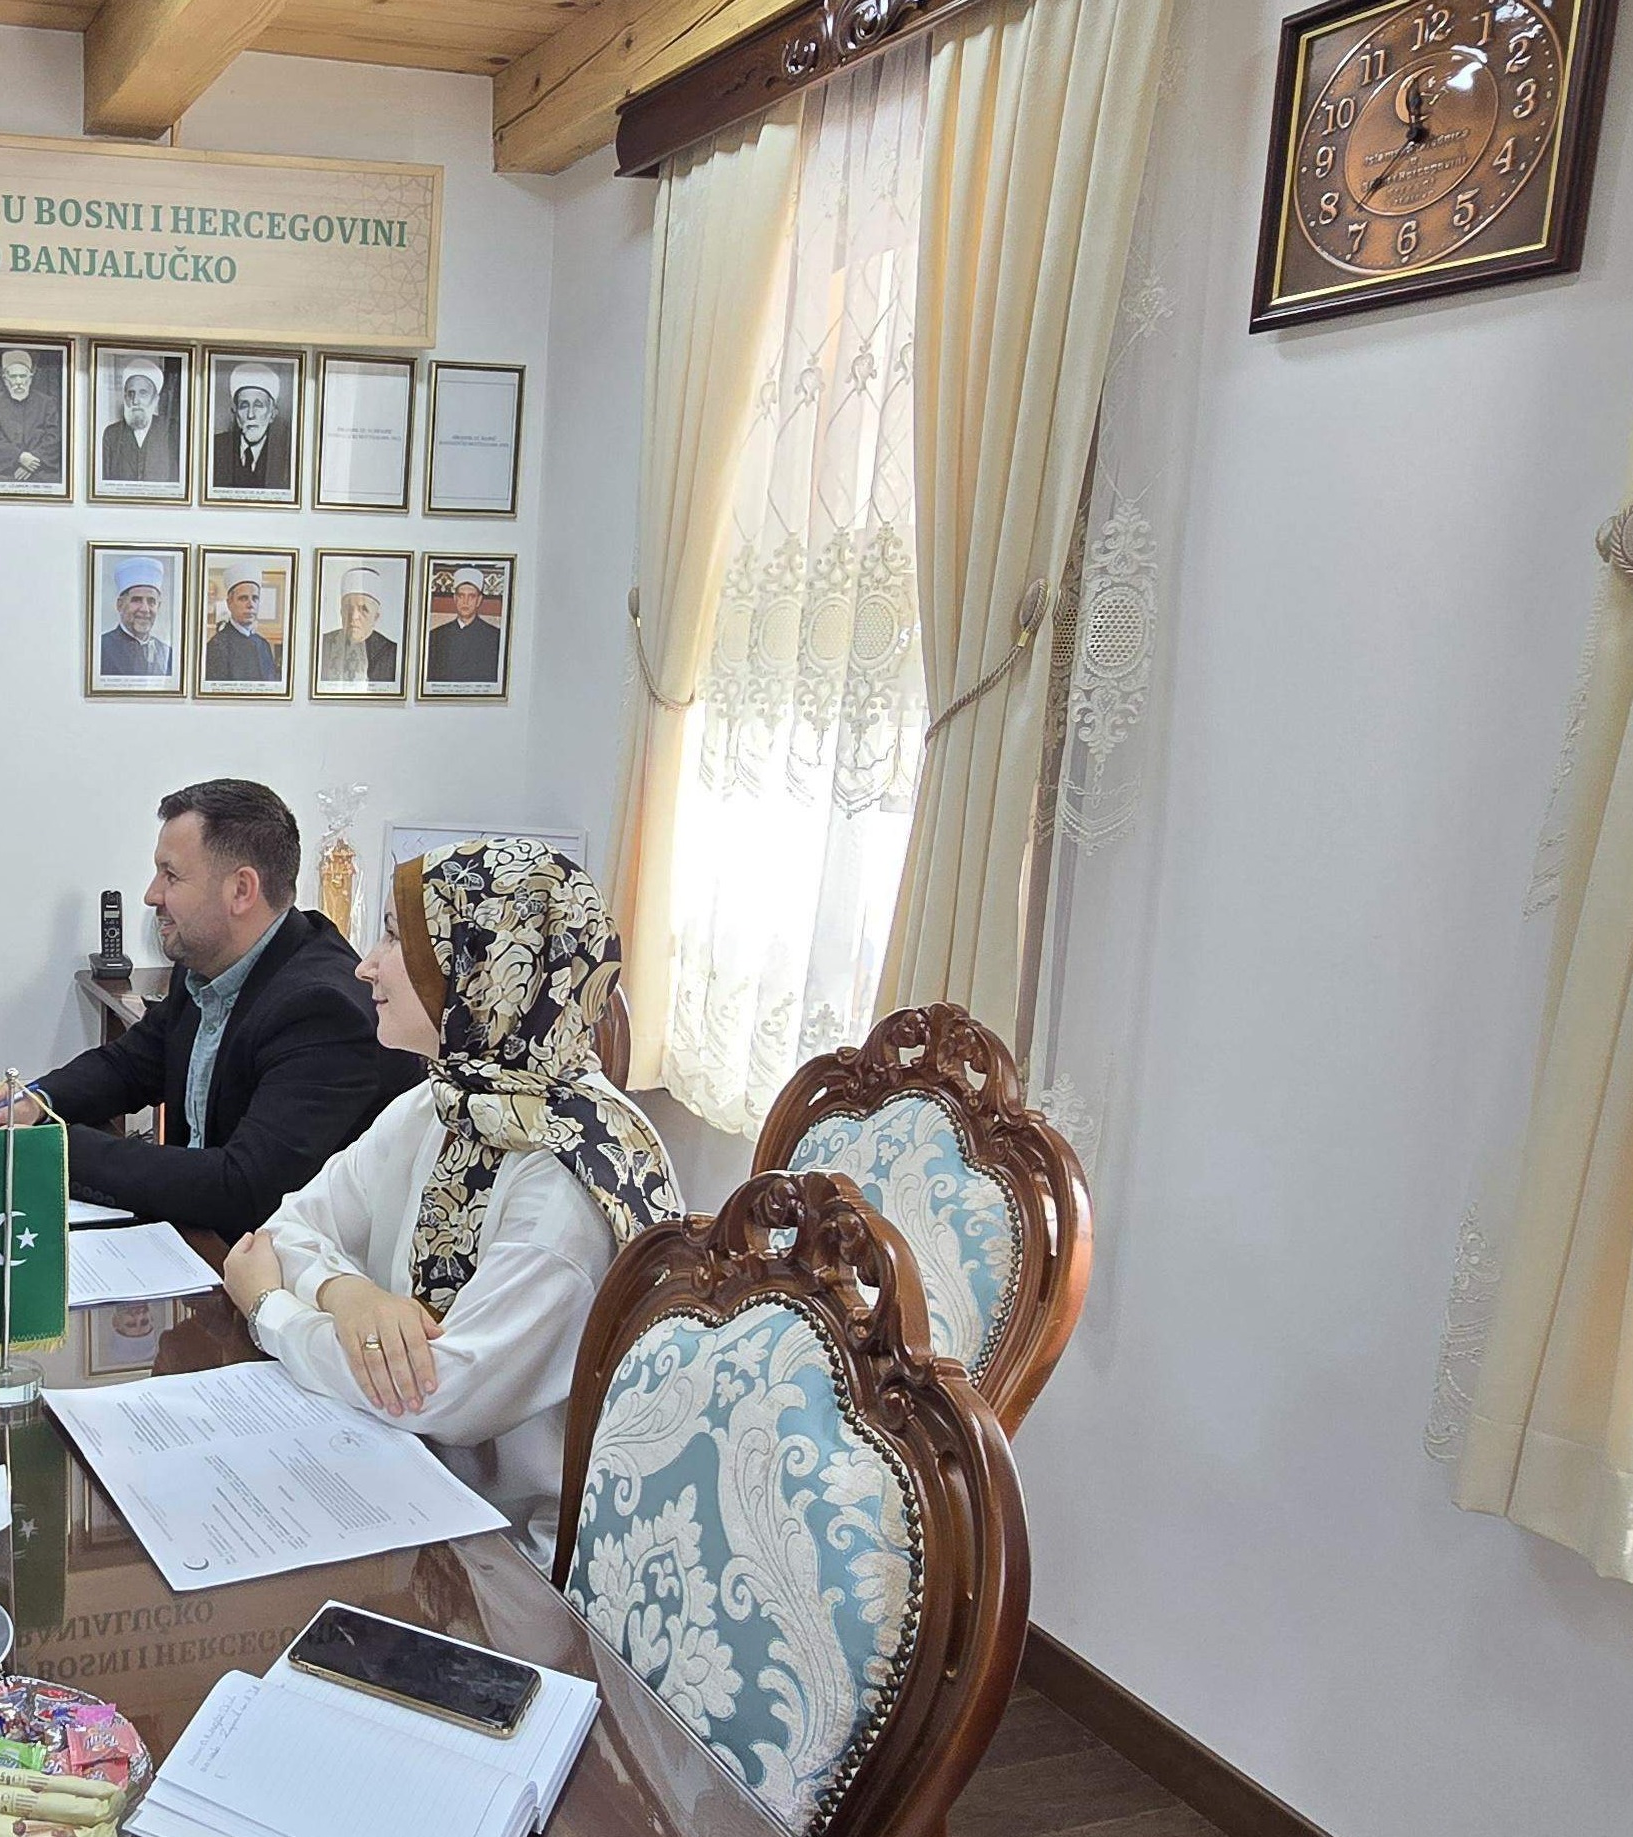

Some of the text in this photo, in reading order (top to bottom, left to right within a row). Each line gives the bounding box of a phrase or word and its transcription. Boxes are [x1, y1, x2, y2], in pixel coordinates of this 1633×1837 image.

[1412, 9, 1451, 51] 12
[1476, 11, 1493, 46] 1
[1361, 49, 1388, 86] 11
[1506, 37, 1530, 73] 2
[1321, 97, 1356, 136] 10
[1513, 79, 1536, 119] 3
[1316, 146, 1335, 178] 9
[1493, 138, 1516, 174] 4
[2, 195, 26, 223] U
[35, 197, 143, 231] BOSNI
[151, 204, 163, 233] I
[171, 206, 408, 249] HERCEGOVINI
[1319, 192, 1340, 225] 8
[1454, 189, 1478, 226] 5
[1348, 221, 1368, 255] 7
[1397, 220, 1418, 255] 6
[9, 244, 237, 284] BANJALUČKO
